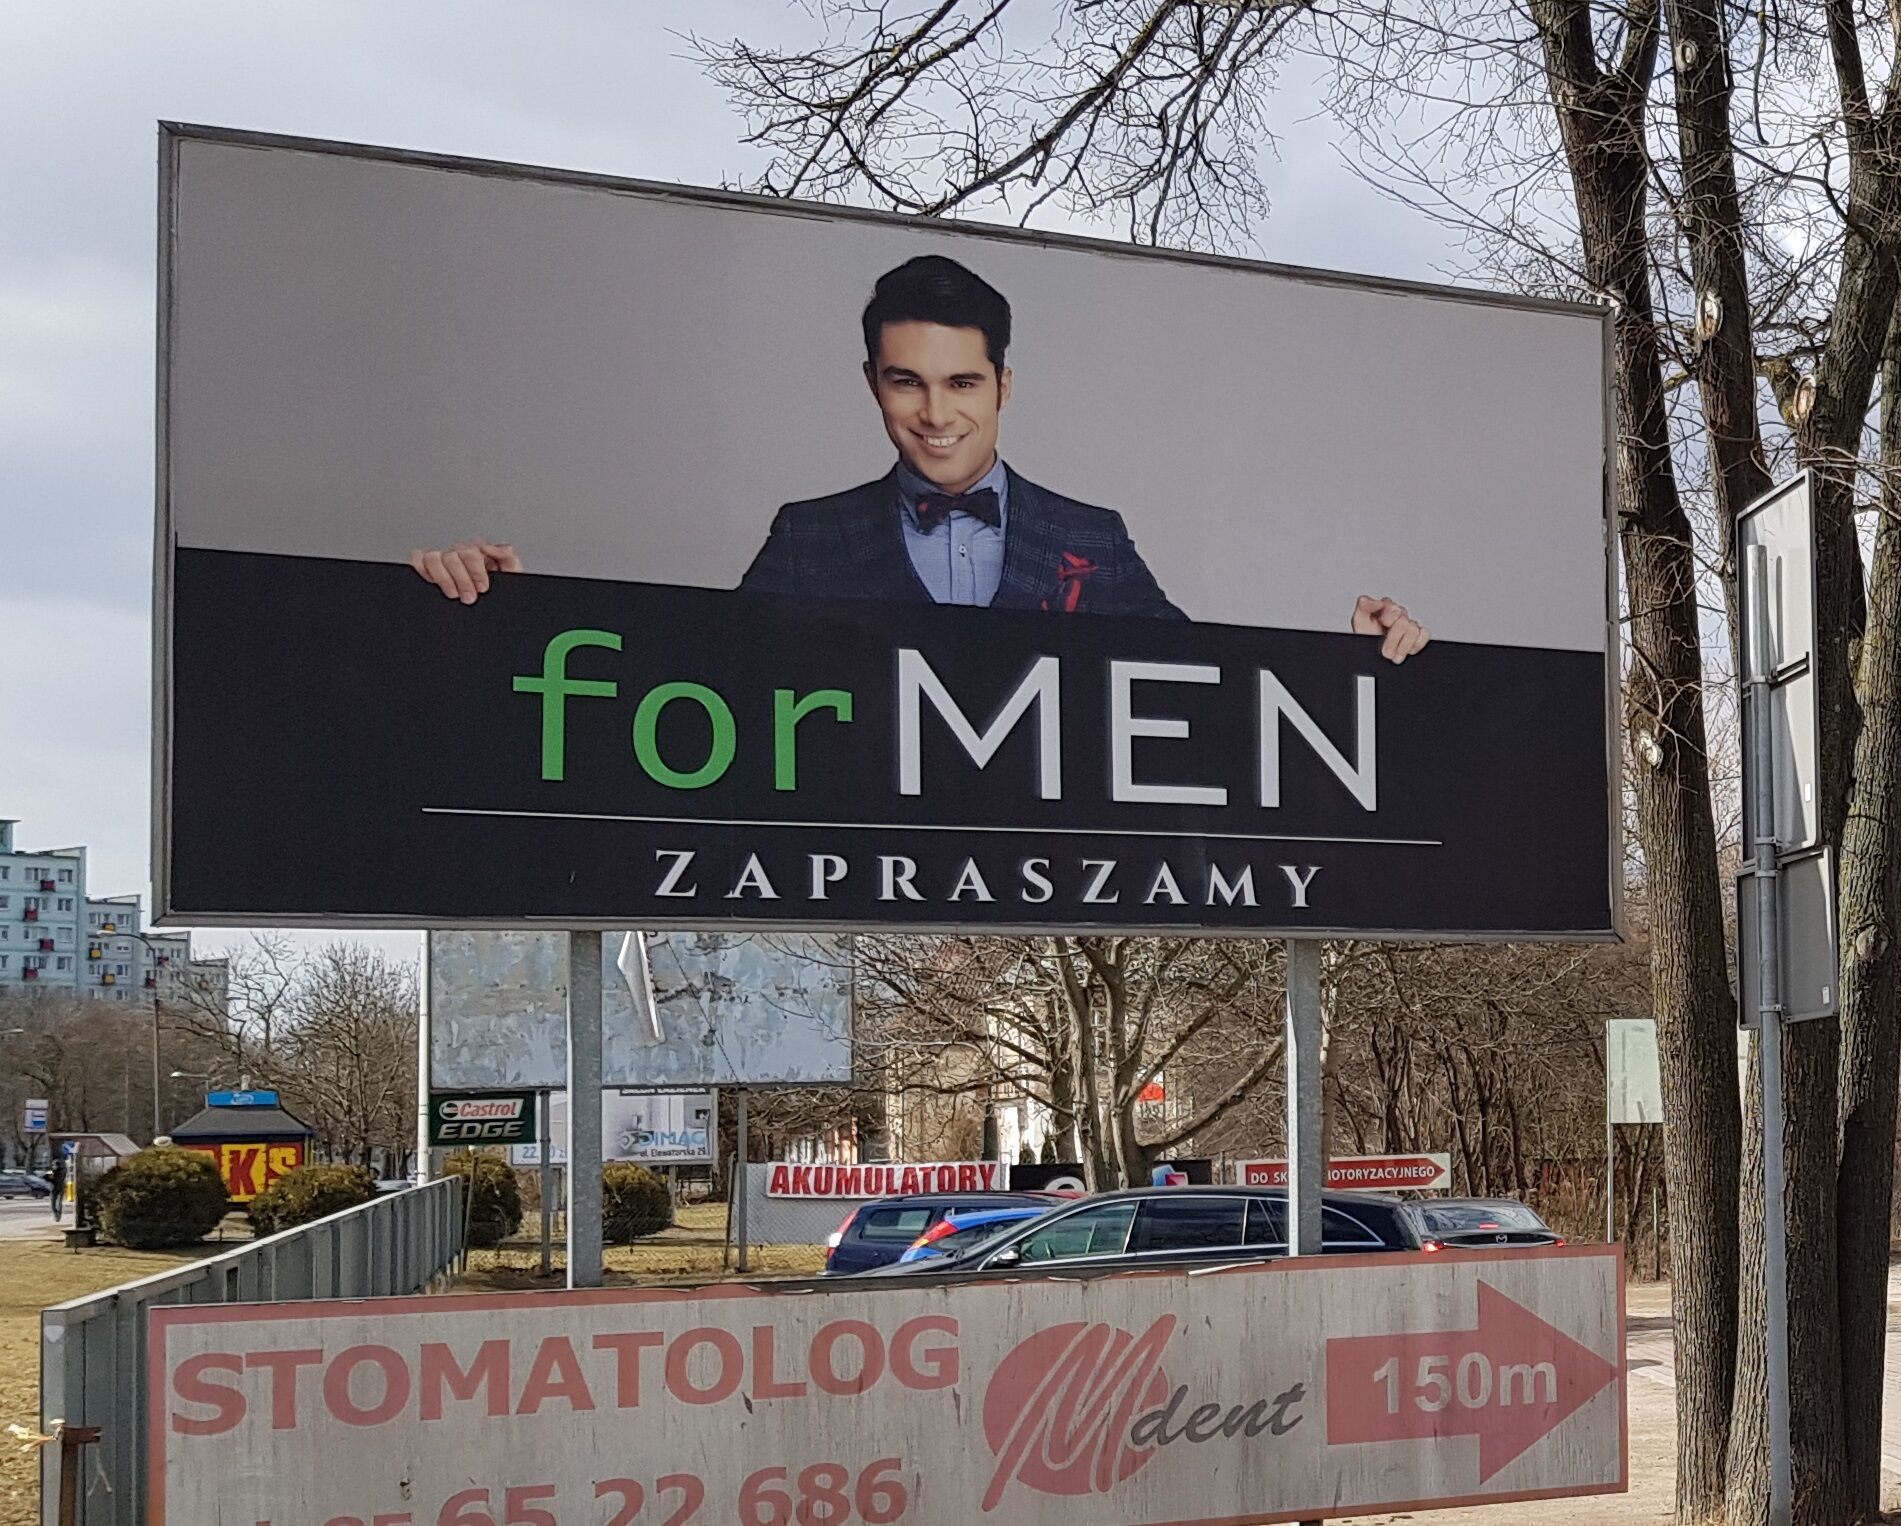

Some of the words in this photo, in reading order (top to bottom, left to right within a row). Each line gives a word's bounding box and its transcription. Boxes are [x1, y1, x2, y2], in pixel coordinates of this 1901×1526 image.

[512, 629, 1377, 811] forMEN
[654, 849, 1323, 908] ZAPRASZAMY
[437, 1121, 526, 1139] EDGE
[460, 1102, 517, 1117] Castrol
[770, 1164, 997, 1195] AKUMULATORY
[1250, 1172, 1269, 1184] DO
[172, 1315, 959, 1436] STOMATOLOG
[1372, 1351, 1559, 1415] 150m
[738, 1457, 909, 1526] 686
